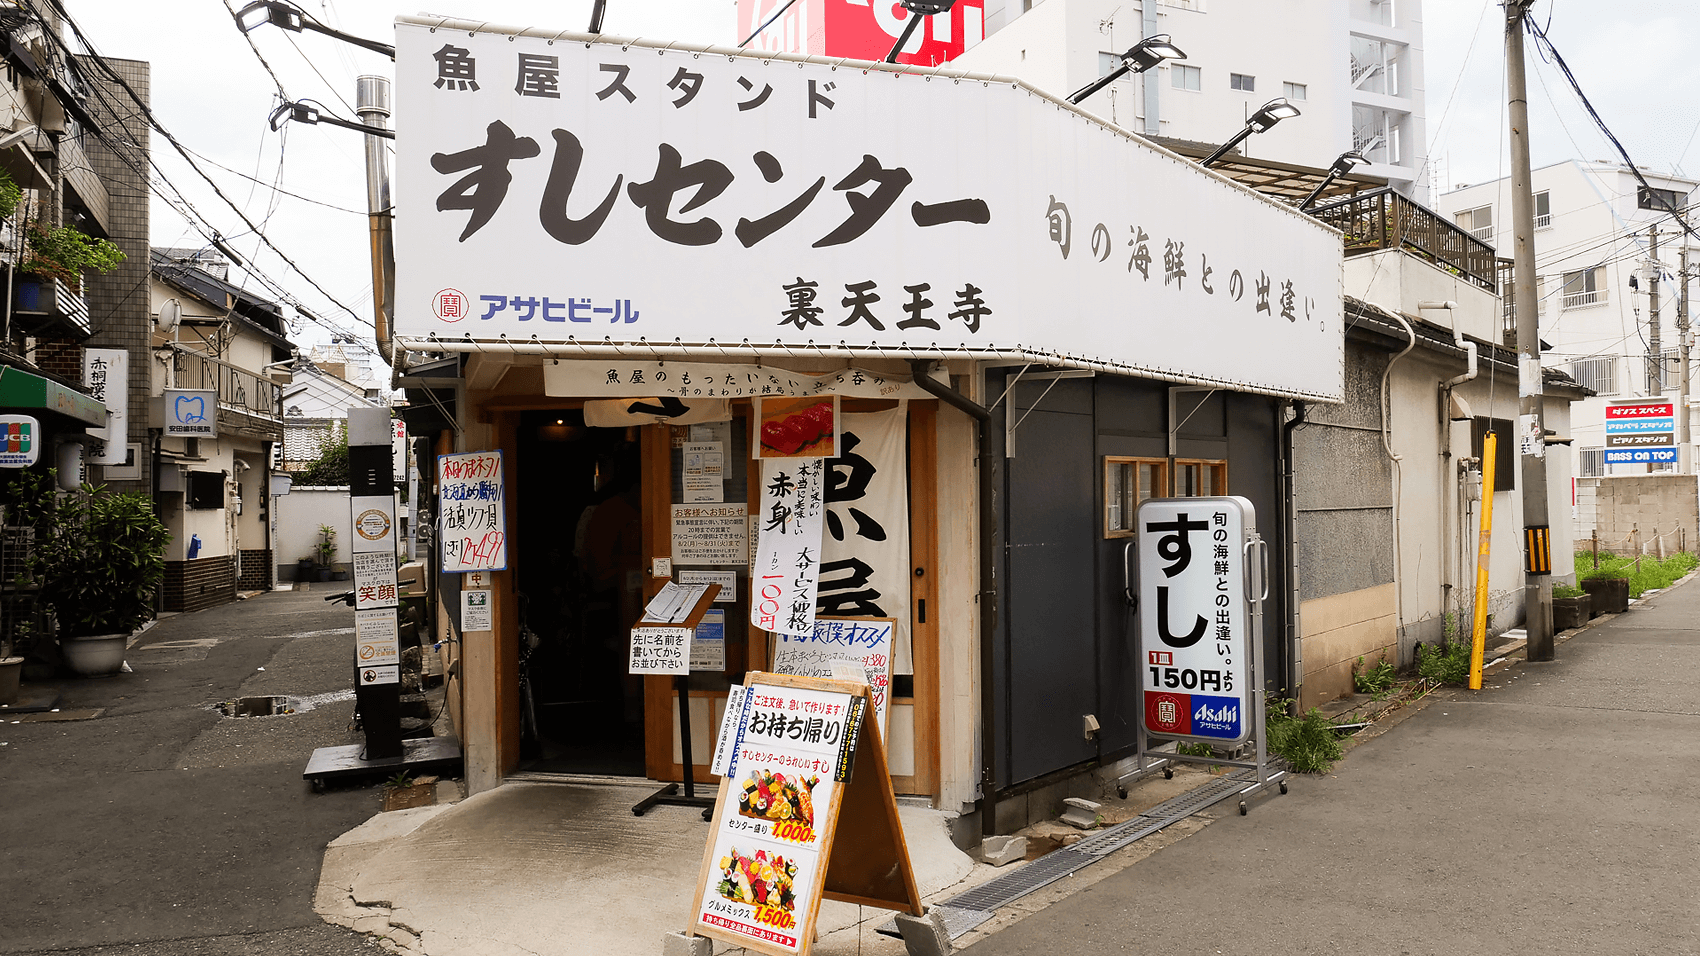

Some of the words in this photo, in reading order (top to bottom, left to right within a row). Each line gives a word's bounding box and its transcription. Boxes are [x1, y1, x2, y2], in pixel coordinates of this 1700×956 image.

[433, 44, 837, 118] 魚屋スタンド
[430, 119, 991, 248] すしセンター
[1045, 194, 1325, 332] 旬の海鮮との出逢い。
[479, 295, 640, 324] アサヒビール
[777, 276, 993, 334] 裏天王寺
[1612, 406, 1637, 415] ダンス
[1638, 406, 1667, 415] スペース
[1640, 421, 1673, 429] スタジオ
[1612, 436, 1633, 444] ピアノ
[1607, 452, 1632, 461] BASS
[1634, 452, 1650, 460] ON
[1652, 451, 1674, 460] TOP
[675, 508, 744, 517] お客様へお知らせ
[762, 472, 797, 535] 赤身
[1146, 513, 1209, 648] すし
[1212, 511, 1232, 666] 旬の海鮮との出逢い。
[359, 584, 396, 602] 笑顔
[633, 635, 684, 645] 先に名前を
[633, 646, 681, 657] 書いてから
[1151, 653, 1170, 664] 1皿
[631, 659, 683, 668] お並び下さい
[1194, 703, 1237, 723] Asahi
[748, 710, 840, 745] お持ち帰り
[1200, 721, 1232, 730] アサヒビール
[728, 818, 768, 835] センター盛り
[771, 821, 817, 843] 1,000円
[708, 899, 751, 919] グルメミックス
[753, 905, 797, 930] 1,500円
